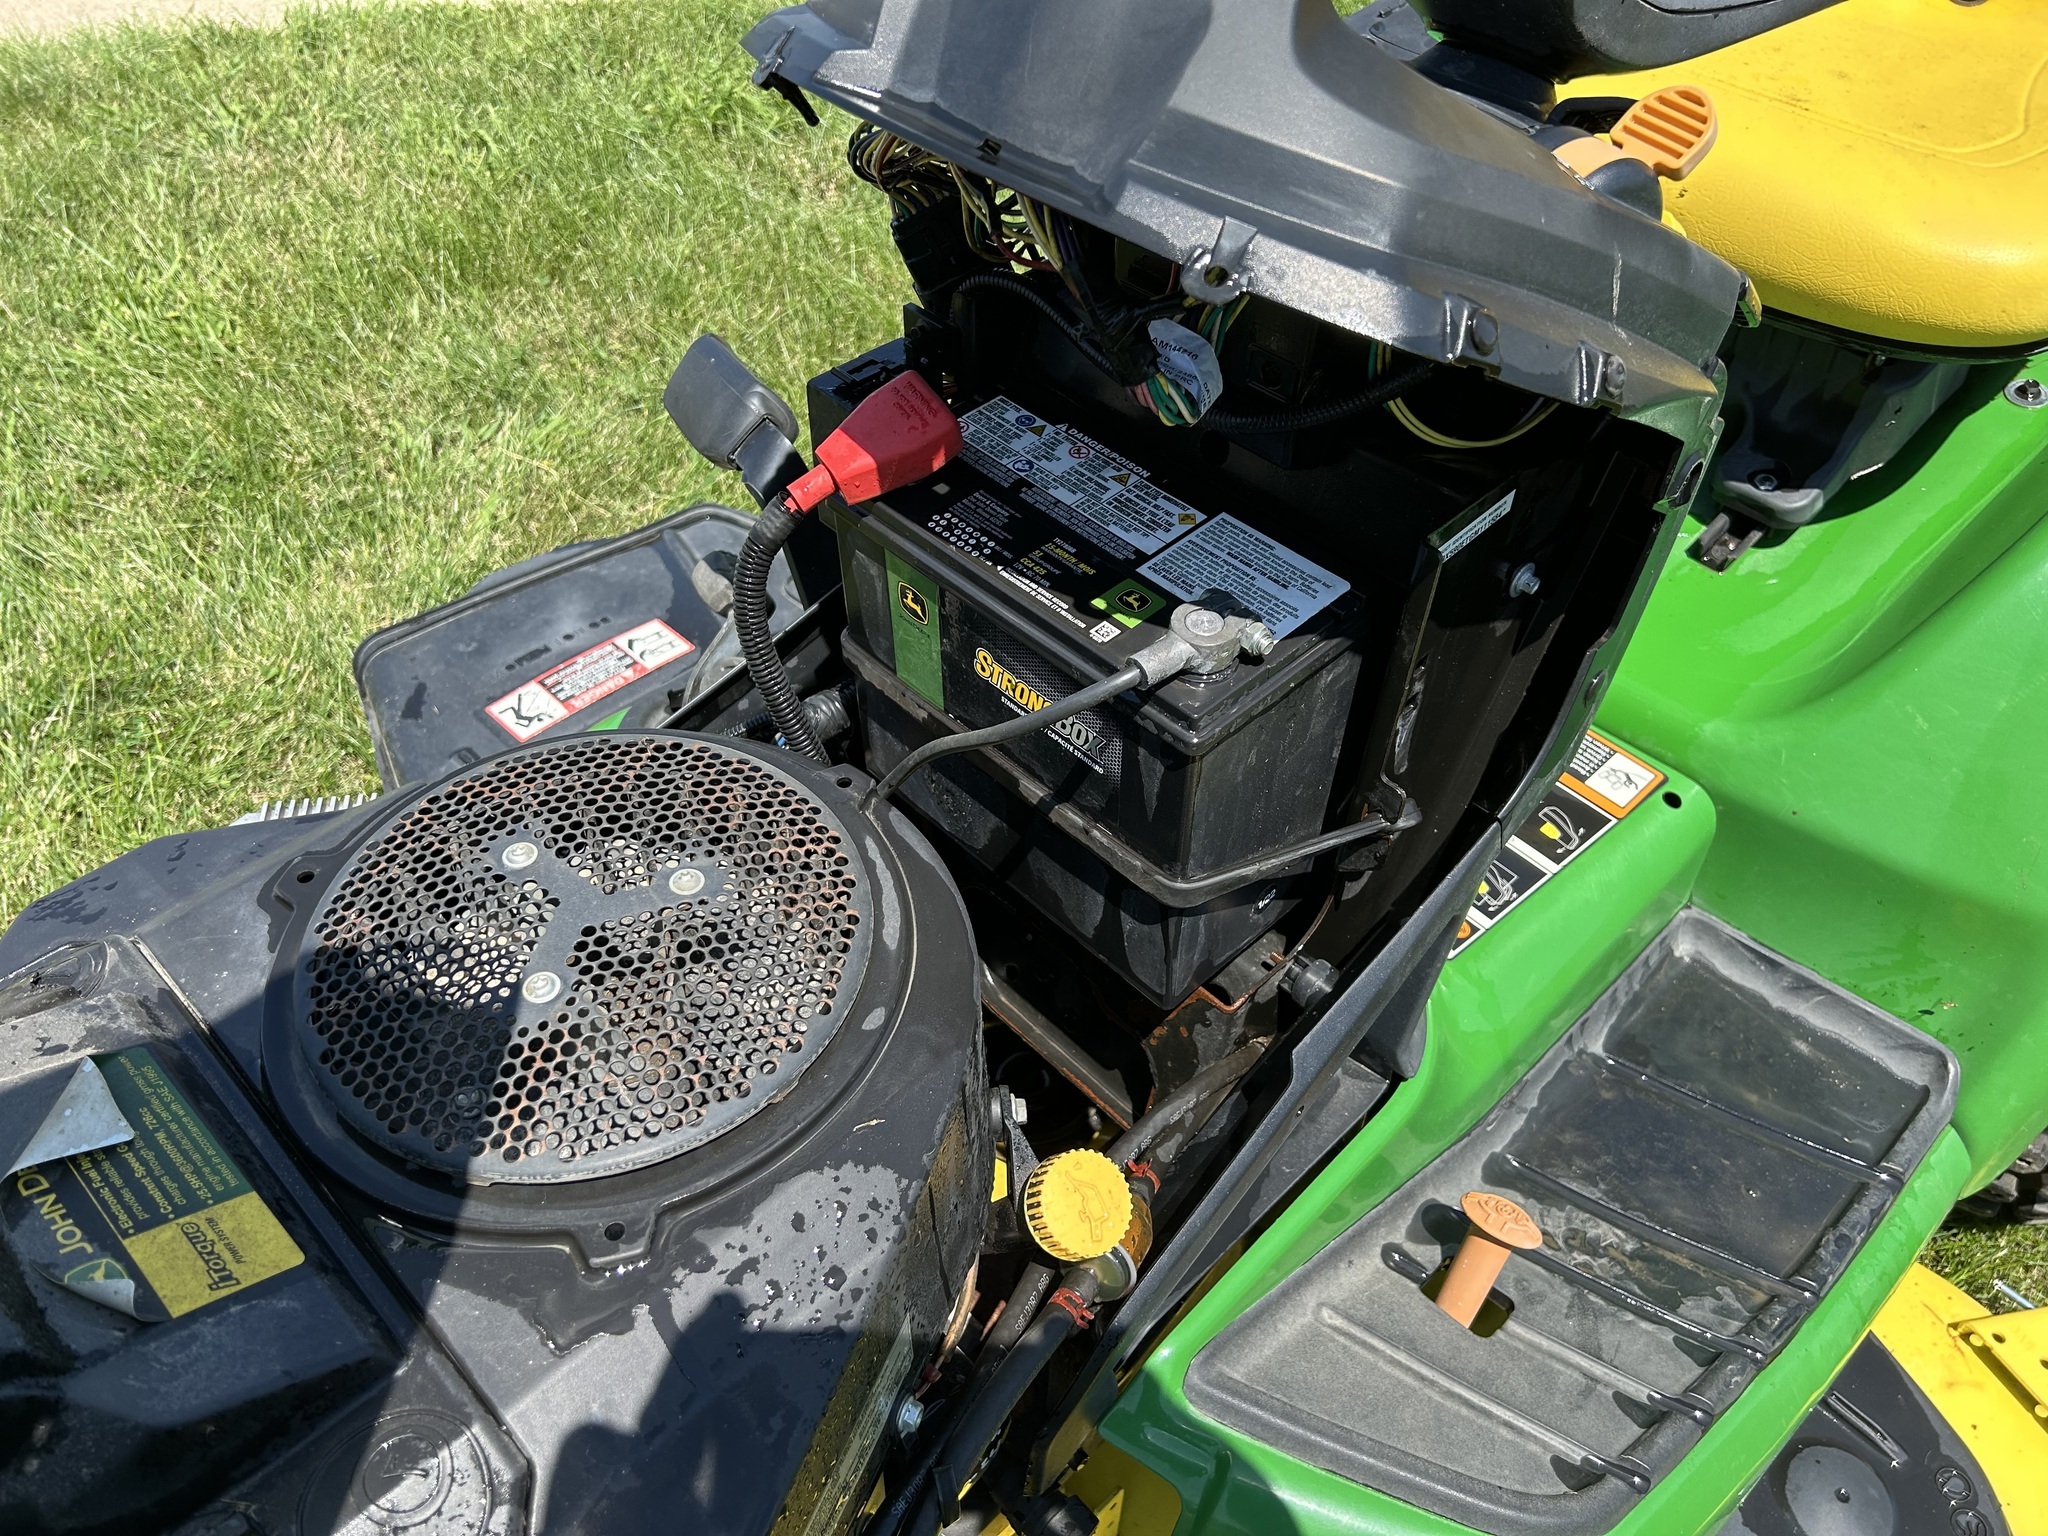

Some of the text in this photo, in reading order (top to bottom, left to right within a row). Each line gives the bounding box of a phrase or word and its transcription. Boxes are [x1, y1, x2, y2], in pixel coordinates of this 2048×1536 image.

[1066, 427, 1151, 478] DANGER/POISON
[1218, 517, 1249, 535] PROPOSITION
[1252, 536, 1277, 551] WARNING:
[1019, 556, 1048, 576] CCA 425
[1043, 541, 1079, 564] 15-MONTH
[1077, 562, 1097, 576] MOIS
[1047, 729, 1074, 752] CAPACITÉ
[1073, 749, 1104, 775] STANDARD
[133, 1073, 154, 1095] gross
[145, 1093, 172, 1122] certified
[139, 1064, 239, 1188] tested in accordance with SAE J1995
[164, 1120, 206, 1167] manufacturer
[121, 1150, 150, 1178] Speed
[135, 1105, 214, 1200] 25.5HP@3600RPM, 726cc
[137, 1146, 167, 1177] through
[82, 1167, 105, 1189] Fuel
[98, 1159, 125, 1188] reliable
[158, 1173, 189, 1206] charges
[199, 1165, 226, 1192] engine
[95, 1186, 135, 1229] Electronic
[118, 1186, 149, 1220] provides
[138, 1176, 174, 1214] Constant
[33, 1192, 93, 1256] JOHN
[204, 1216, 246, 1266] POWER SYSTEM
[180, 1221, 241, 1291] iTorque
[1014, 1273, 1051, 1334] SAEJ30R7 ABG
